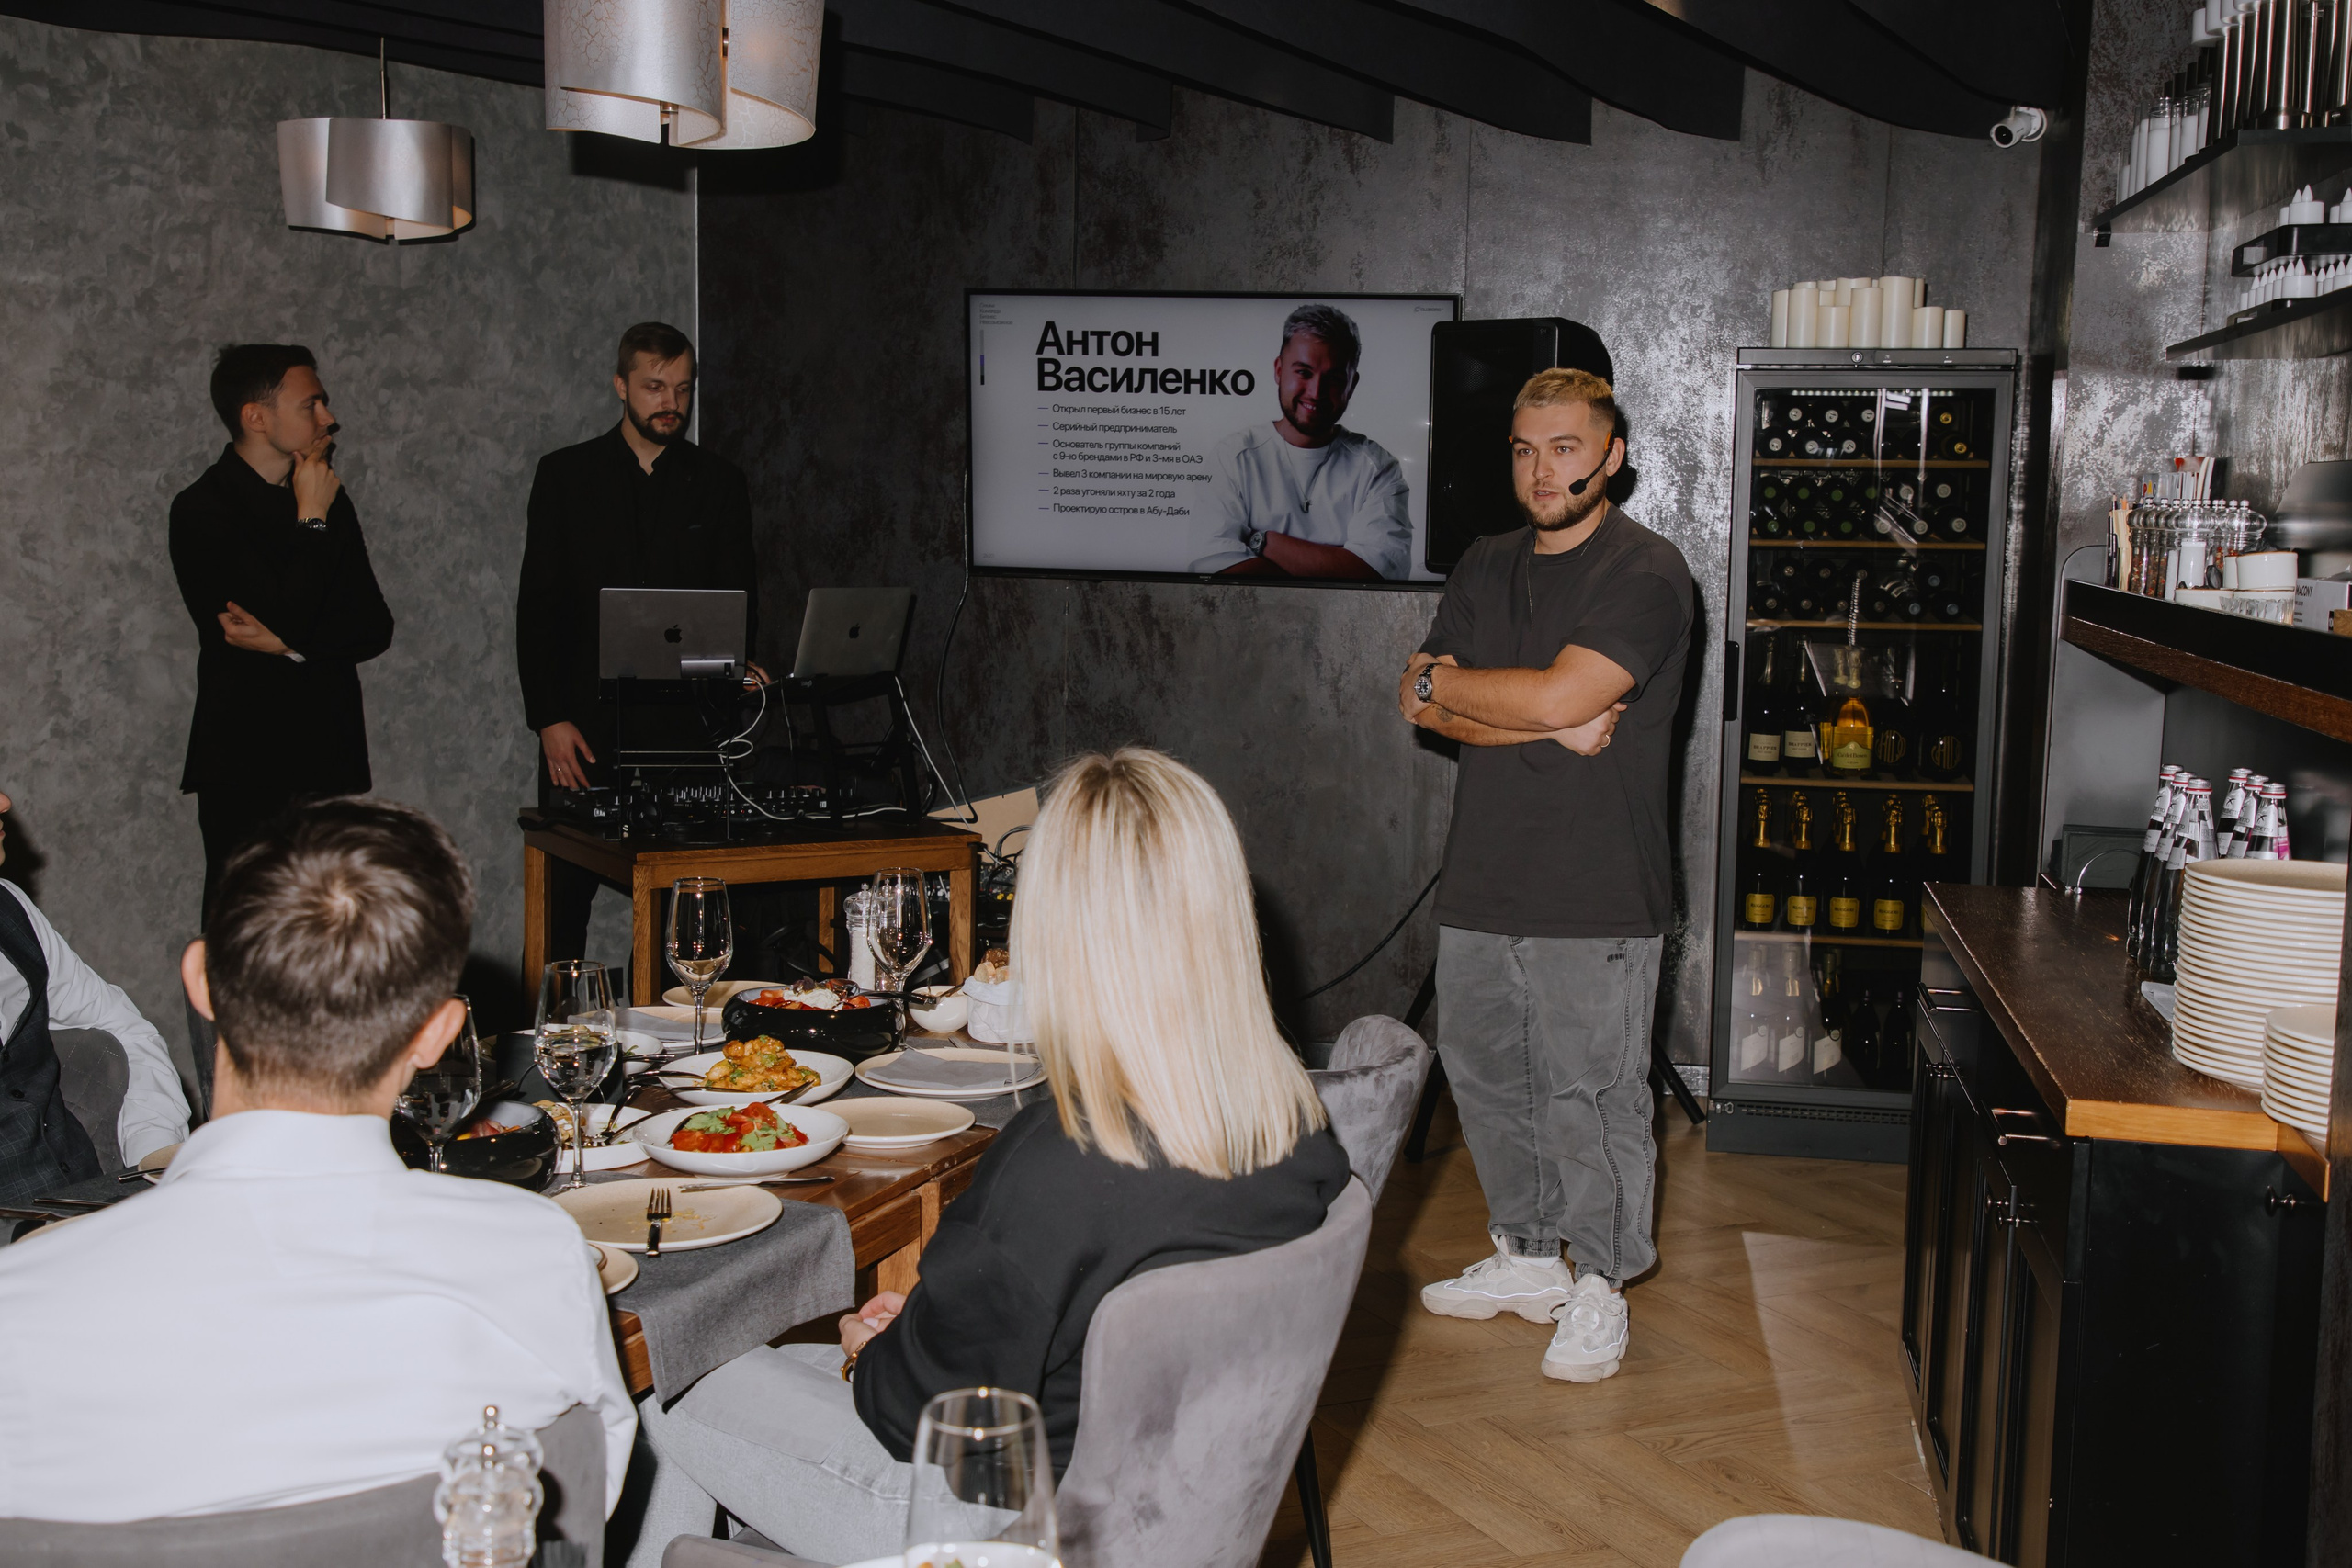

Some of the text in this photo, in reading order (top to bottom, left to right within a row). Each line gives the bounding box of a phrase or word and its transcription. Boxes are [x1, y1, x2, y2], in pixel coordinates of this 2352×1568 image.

[1035, 321, 1159, 357] Антон
[1037, 357, 1256, 397] Василенко
[1052, 403, 1086, 415] Открыл
[1087, 405, 1120, 416] первый
[1121, 405, 1152, 415] бизнес
[1159, 406, 1170, 415] 15
[1171, 408, 1186, 416] лет
[1052, 422, 1178, 434] Серийный предприниматель
[1052, 439, 1181, 451] Основатель группы компаний
[1059, 452, 1077, 461] 9-ю
[1077, 452, 1123, 462] брендами
[1129, 454, 1145, 462] РФ
[1152, 454, 1174, 463] 3-мя
[1182, 455, 1204, 463] ОАЭ
[1052, 468, 1080, 478] Вывел
[1081, 469, 1088, 479] 3
[1089, 471, 1132, 479] компании
[1145, 473, 1185, 482] мировую
[1186, 474, 1213, 483] арену
[1053, 487, 1059, 495] 2
[1060, 489, 1080, 497] раза
[1081, 489, 1116, 498] угоняли
[1117, 490, 1136, 499] яхту
[1148, 489, 1154, 498] 2
[1155, 490, 1176, 499] года
[1053, 503, 1191, 517] Проектирую остров в Абу-Даби
